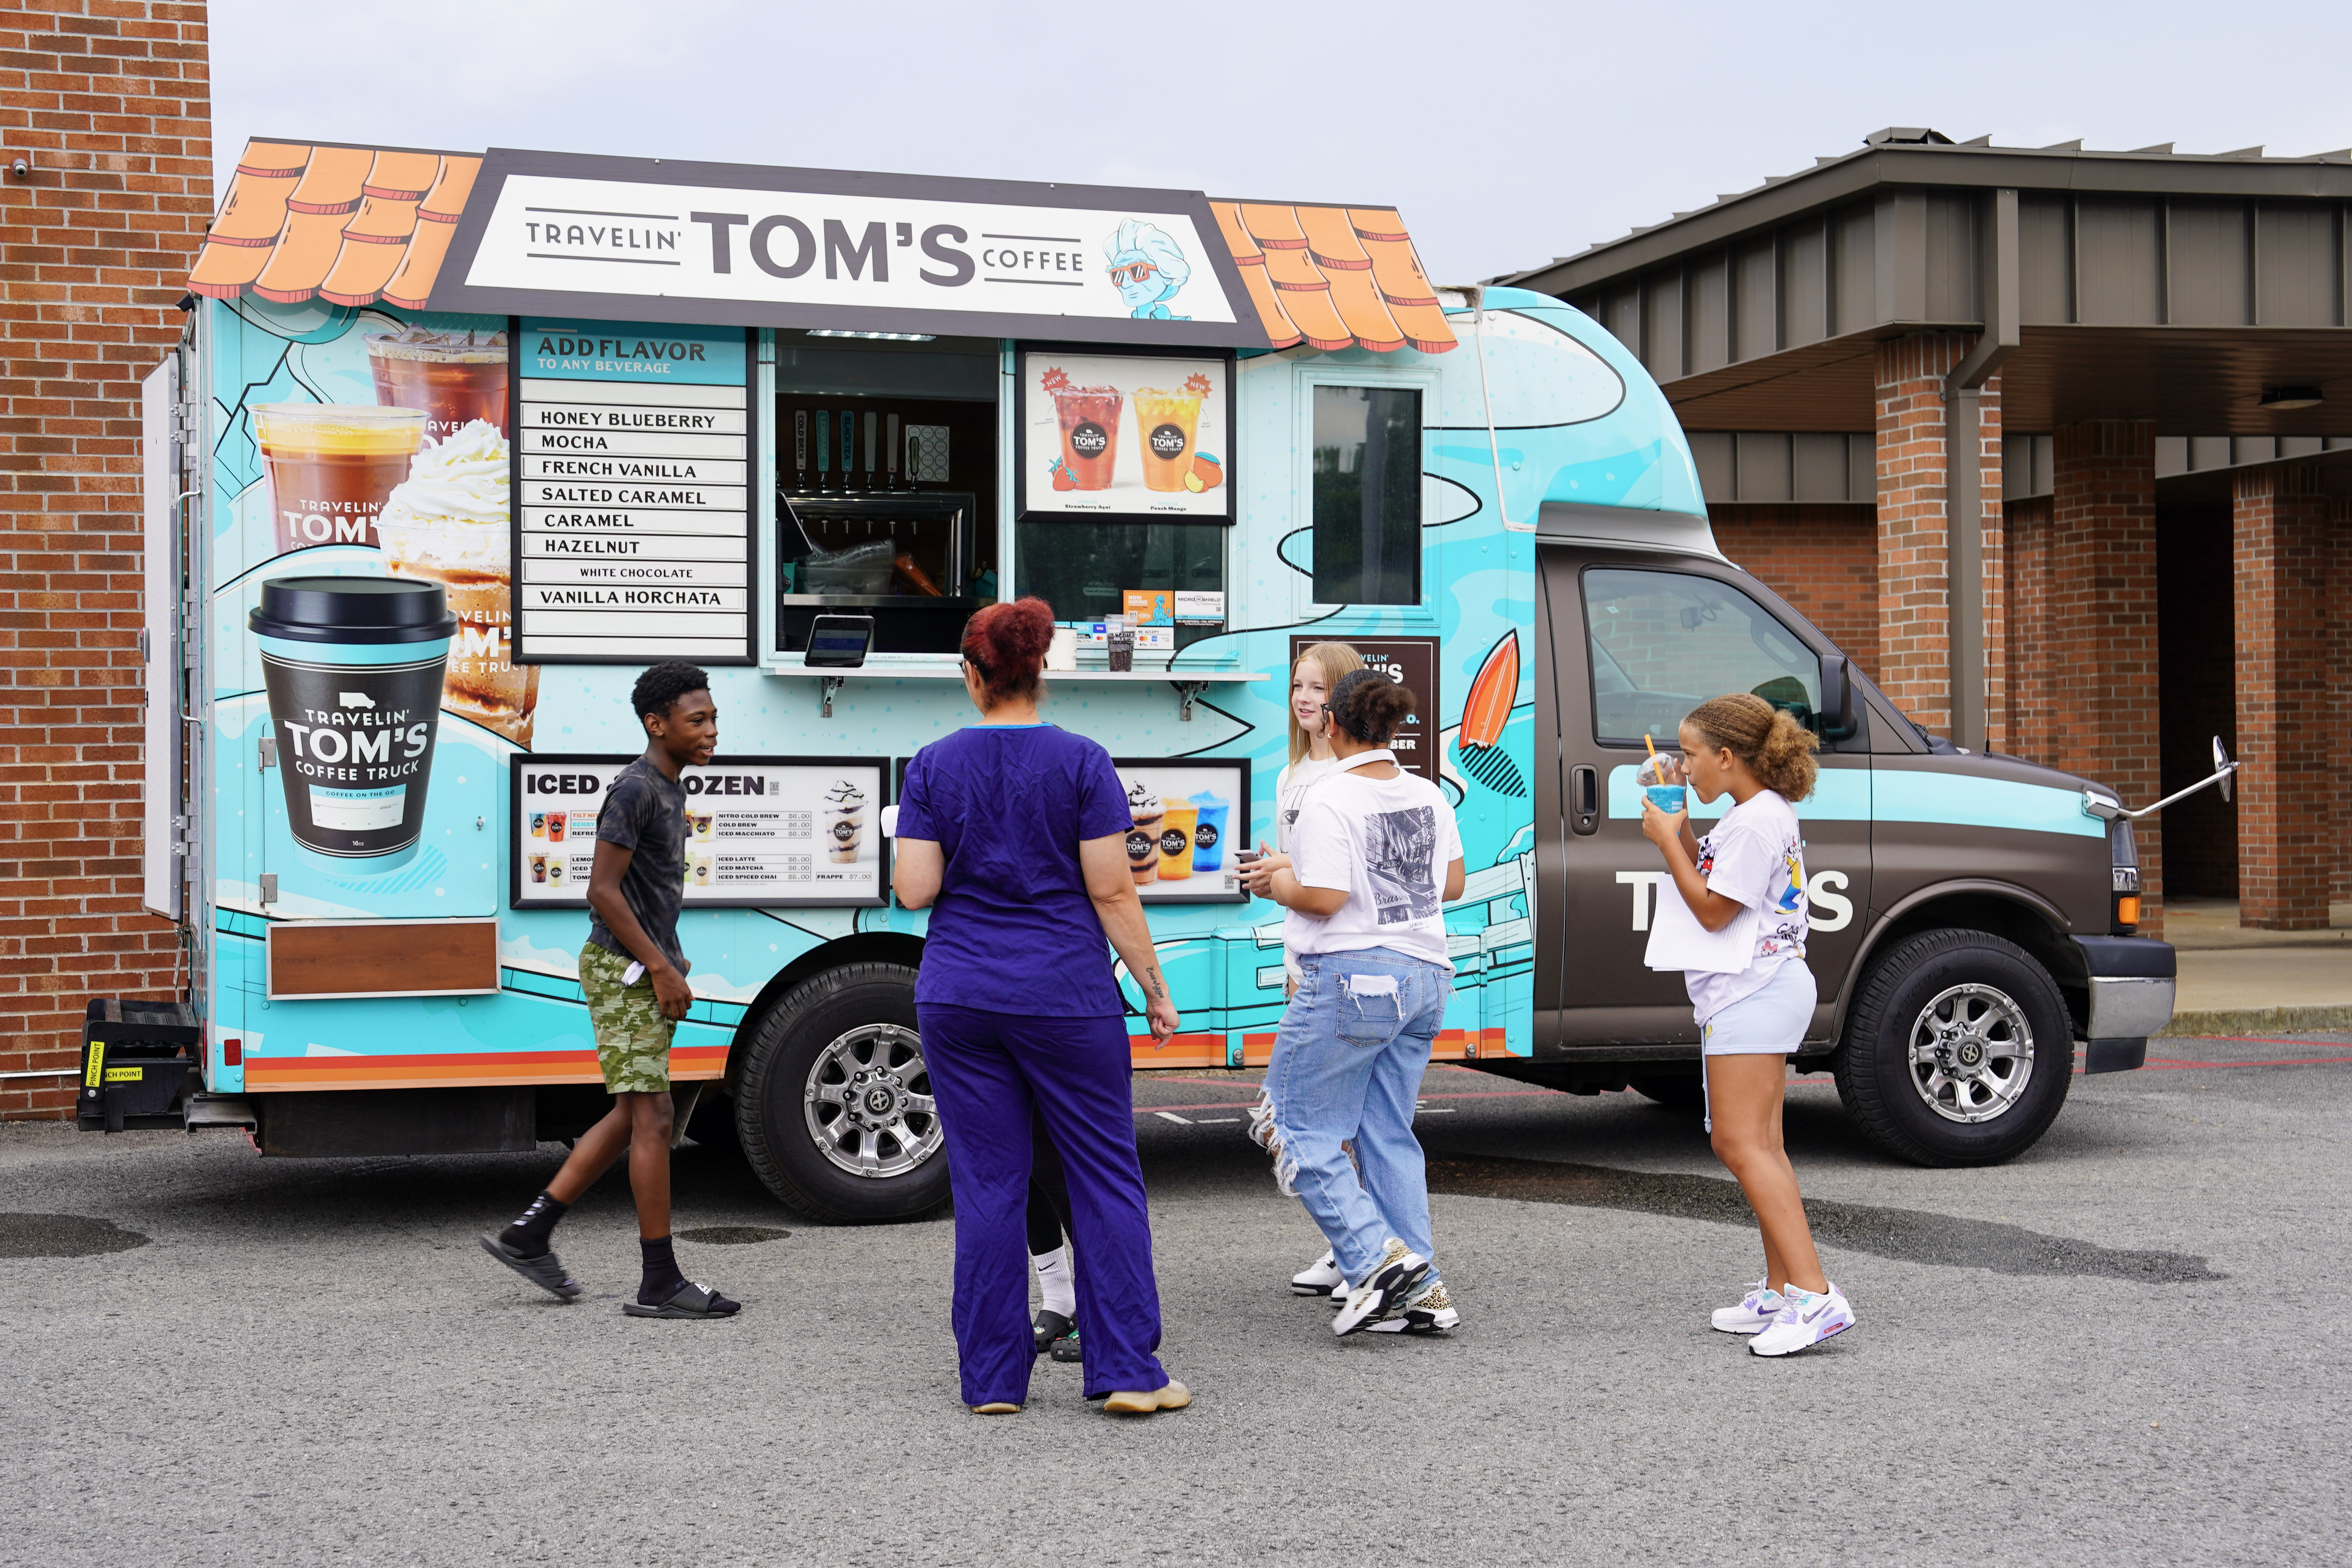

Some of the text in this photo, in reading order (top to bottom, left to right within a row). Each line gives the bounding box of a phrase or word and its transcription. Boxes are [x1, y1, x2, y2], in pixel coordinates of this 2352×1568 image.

[526, 212, 1084, 288] TRAVELIN' TOM'S COFFEE
[538, 337, 706, 361] ADD FLAVOR
[537, 358, 670, 373] TO ANY BEVERAGE
[1046, 375, 1061, 387] NEW
[1190, 381, 1206, 390] NEW
[541, 412, 715, 428] HONEY BLUEBERRY
[542, 435, 608, 449] MOCHA
[1074, 436, 1105, 446] TOM'S
[1152, 437, 1184, 447] TOM'S
[543, 461, 697, 478] FRENCH VANILLA
[542, 488, 706, 505] SALTED CARAMEL
[300, 499, 381, 513] TRAVELIN'
[283, 510, 377, 542] TOM'
[545, 514, 634, 527] CARAMEL
[545, 540, 640, 554] HAZELNUT
[580, 568, 694, 578] WHITE CHOCOLATE
[541, 591, 721, 605] VANILLA HORCHATA
[305, 709, 410, 726] TRAVELIN'
[284, 720, 428, 764] TOM'S
[296, 760, 418, 781] COFFEE TRUCK
[527, 774, 600, 794] ICED
[686, 775, 764, 795] OZEN
